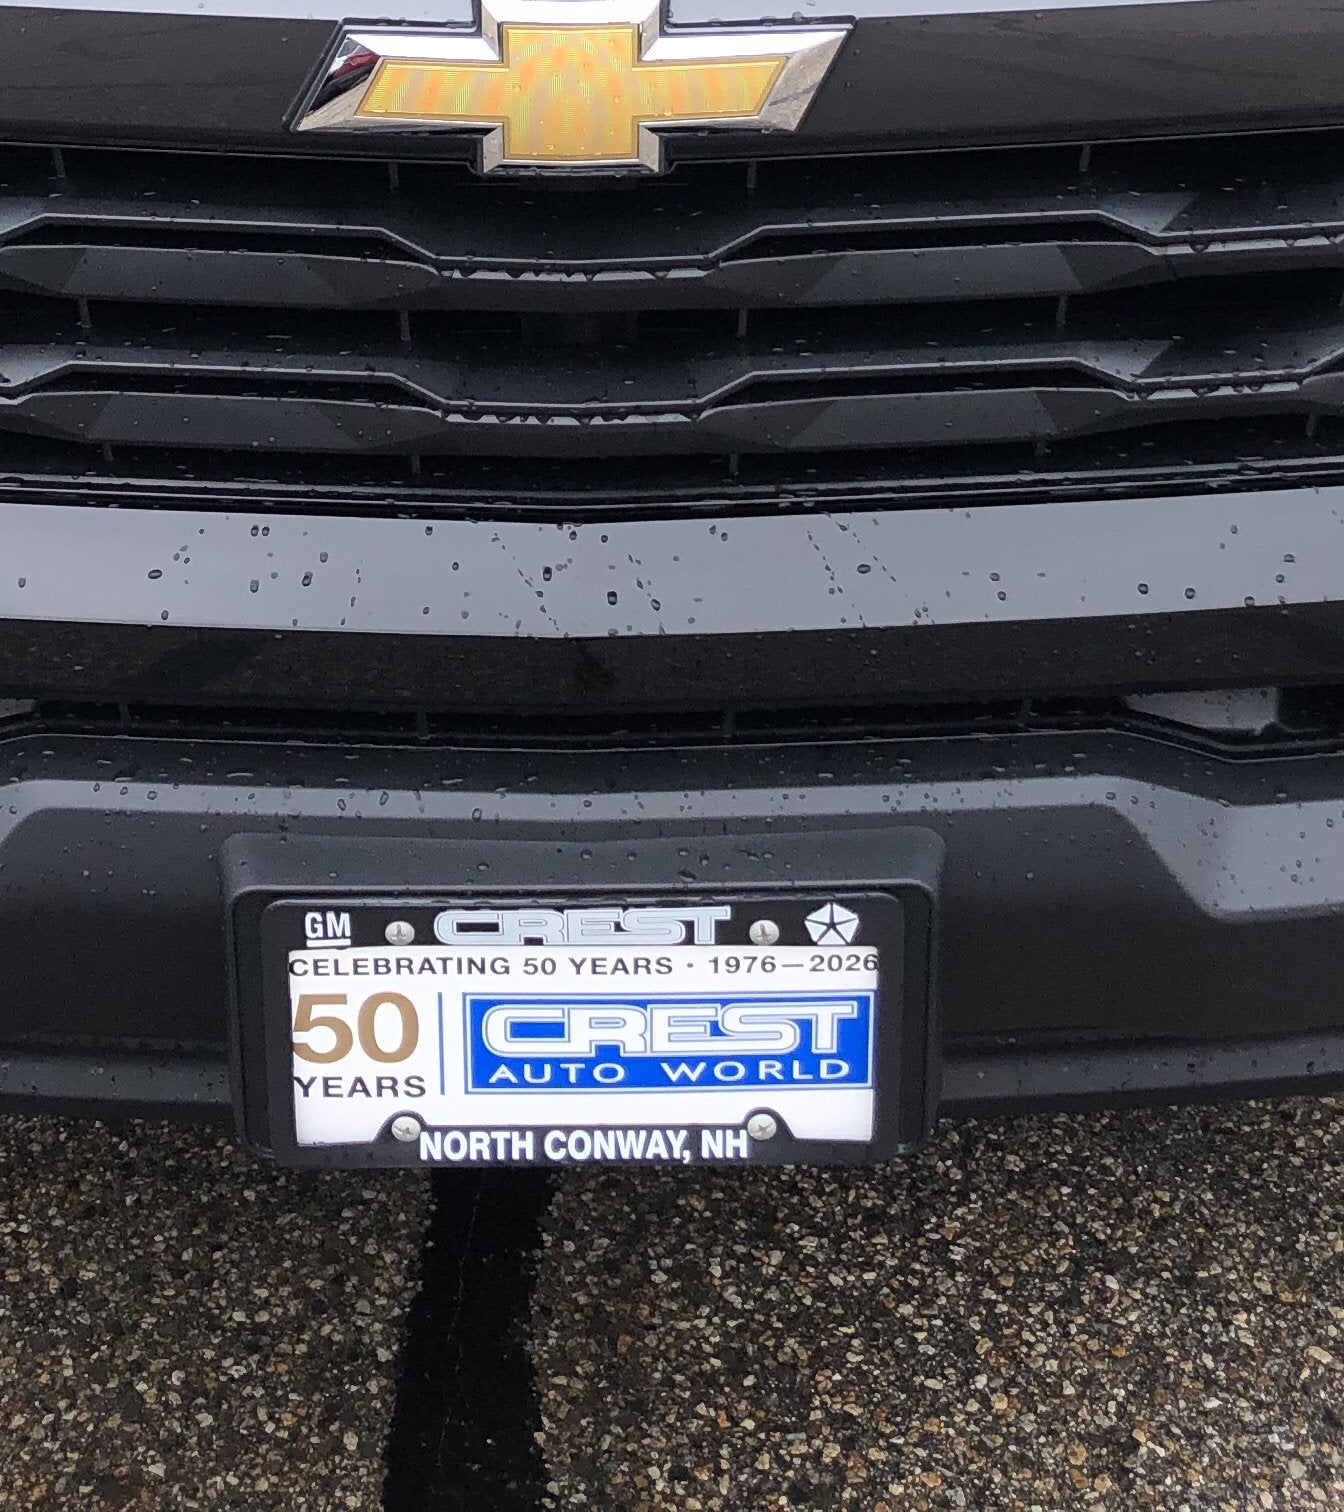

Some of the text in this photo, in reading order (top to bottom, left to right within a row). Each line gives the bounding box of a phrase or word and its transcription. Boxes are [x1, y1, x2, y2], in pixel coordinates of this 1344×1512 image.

[306, 911, 351, 939] GM
[434, 905, 731, 945] CREST
[289, 956, 510, 977] CELEBRATING
[523, 956, 557, 976] 50
[568, 956, 673, 976] YEARS
[293, 991, 419, 1064] 50
[481, 1001, 858, 1059] CREST
[293, 1075, 426, 1098] YEARS
[488, 1059, 850, 1084] AUTO WORLD
[419, 1128, 748, 1164] NORTH CONWAY, NH
